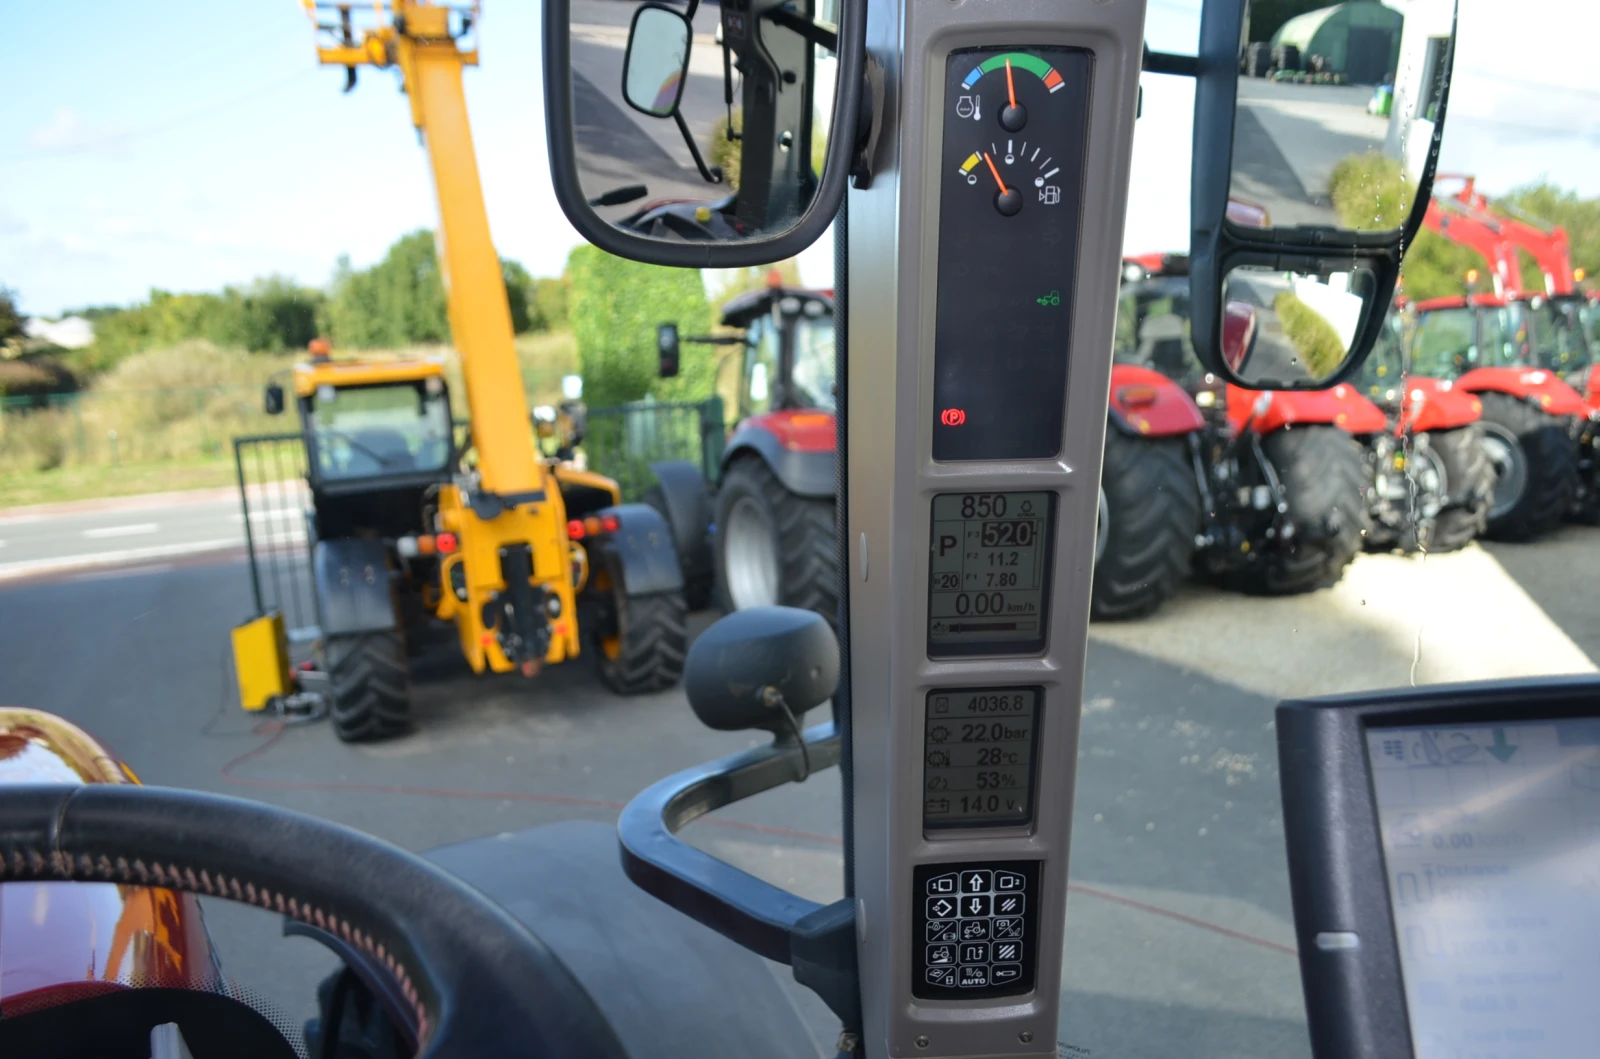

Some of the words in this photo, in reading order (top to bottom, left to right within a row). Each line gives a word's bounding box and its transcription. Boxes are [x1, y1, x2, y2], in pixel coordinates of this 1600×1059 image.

[961, 494, 1008, 518] 850
[967, 531, 980, 539] F3
[984, 522, 1032, 547] 52.0
[939, 535, 958, 557] P
[966, 552, 979, 560] F2
[988, 551, 1020, 567] 11.2
[965, 573, 978, 581] F1
[986, 572, 1018, 588] 7.80
[955, 592, 1004, 616] 0.00
[1007, 602, 1035, 613] km/h
[968, 695, 1023, 712] 4036.8
[962, 723, 1003, 742] 22.0
[1004, 726, 1029, 740] bar
[977, 747, 1002, 765] 28
[976, 771, 1000, 789] 53
[961, 795, 999, 813] 14.0
[961, 977, 986, 986] AUTO
